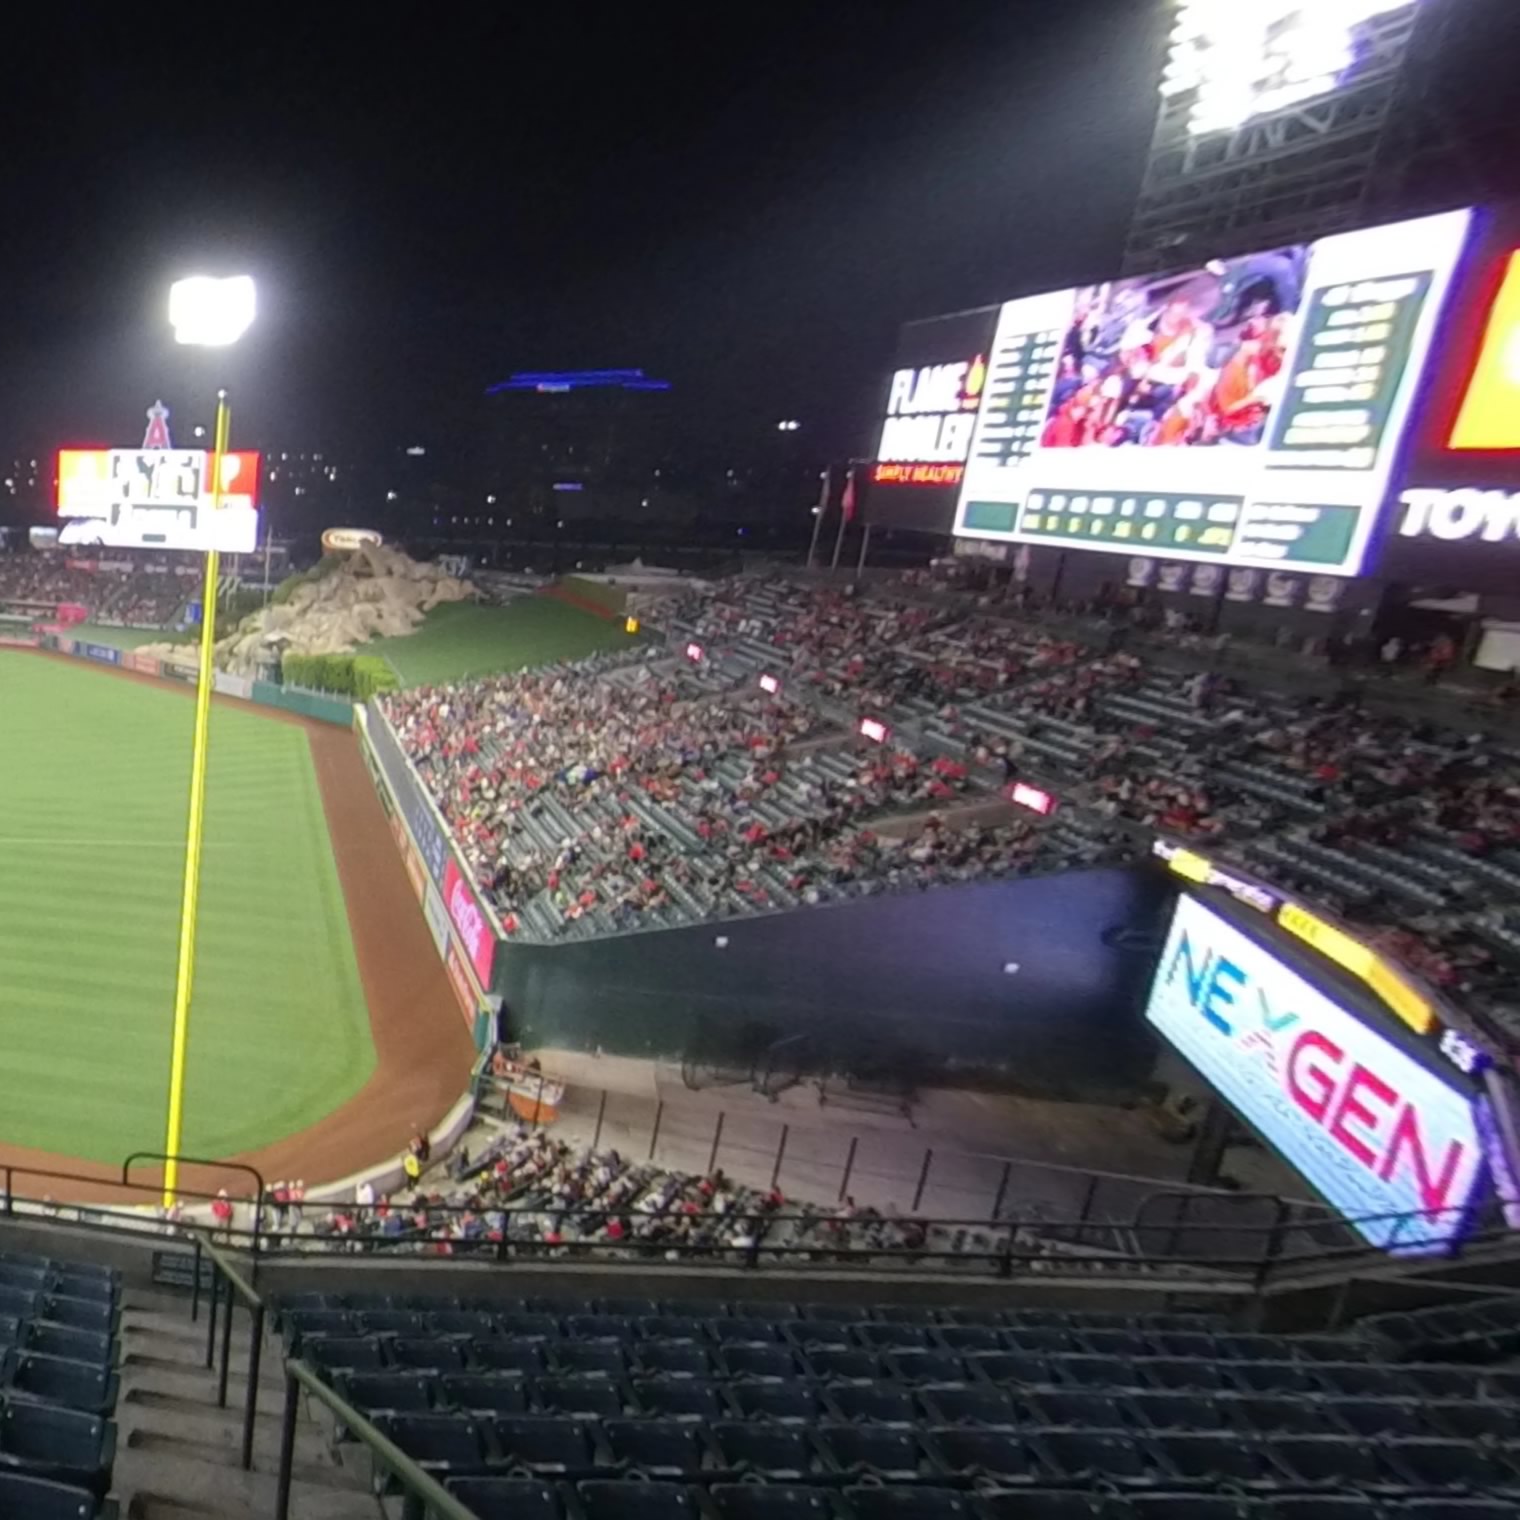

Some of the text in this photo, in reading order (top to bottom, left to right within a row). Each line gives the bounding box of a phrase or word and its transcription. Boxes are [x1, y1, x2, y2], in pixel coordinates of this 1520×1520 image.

[887, 361, 968, 415] FLAME
[1399, 487, 1520, 542] TOY
[1166, 928, 1465, 1225] NEXGEN
